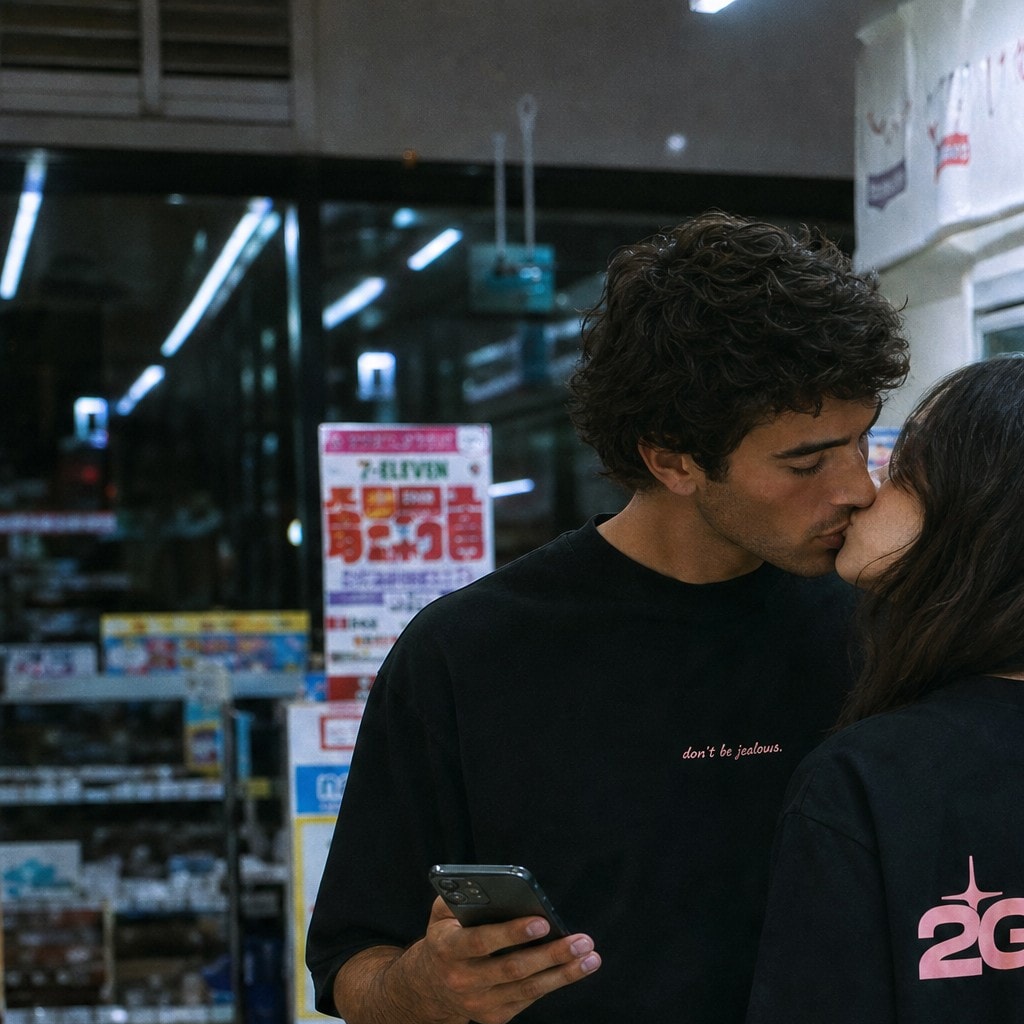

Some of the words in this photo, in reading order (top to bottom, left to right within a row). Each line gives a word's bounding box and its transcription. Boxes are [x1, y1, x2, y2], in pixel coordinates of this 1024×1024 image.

[358, 460, 449, 480] 7-ELEVEN
[682, 746, 715, 759] don't
[720, 744, 732, 757] be
[735, 742, 782, 760] jealous.
